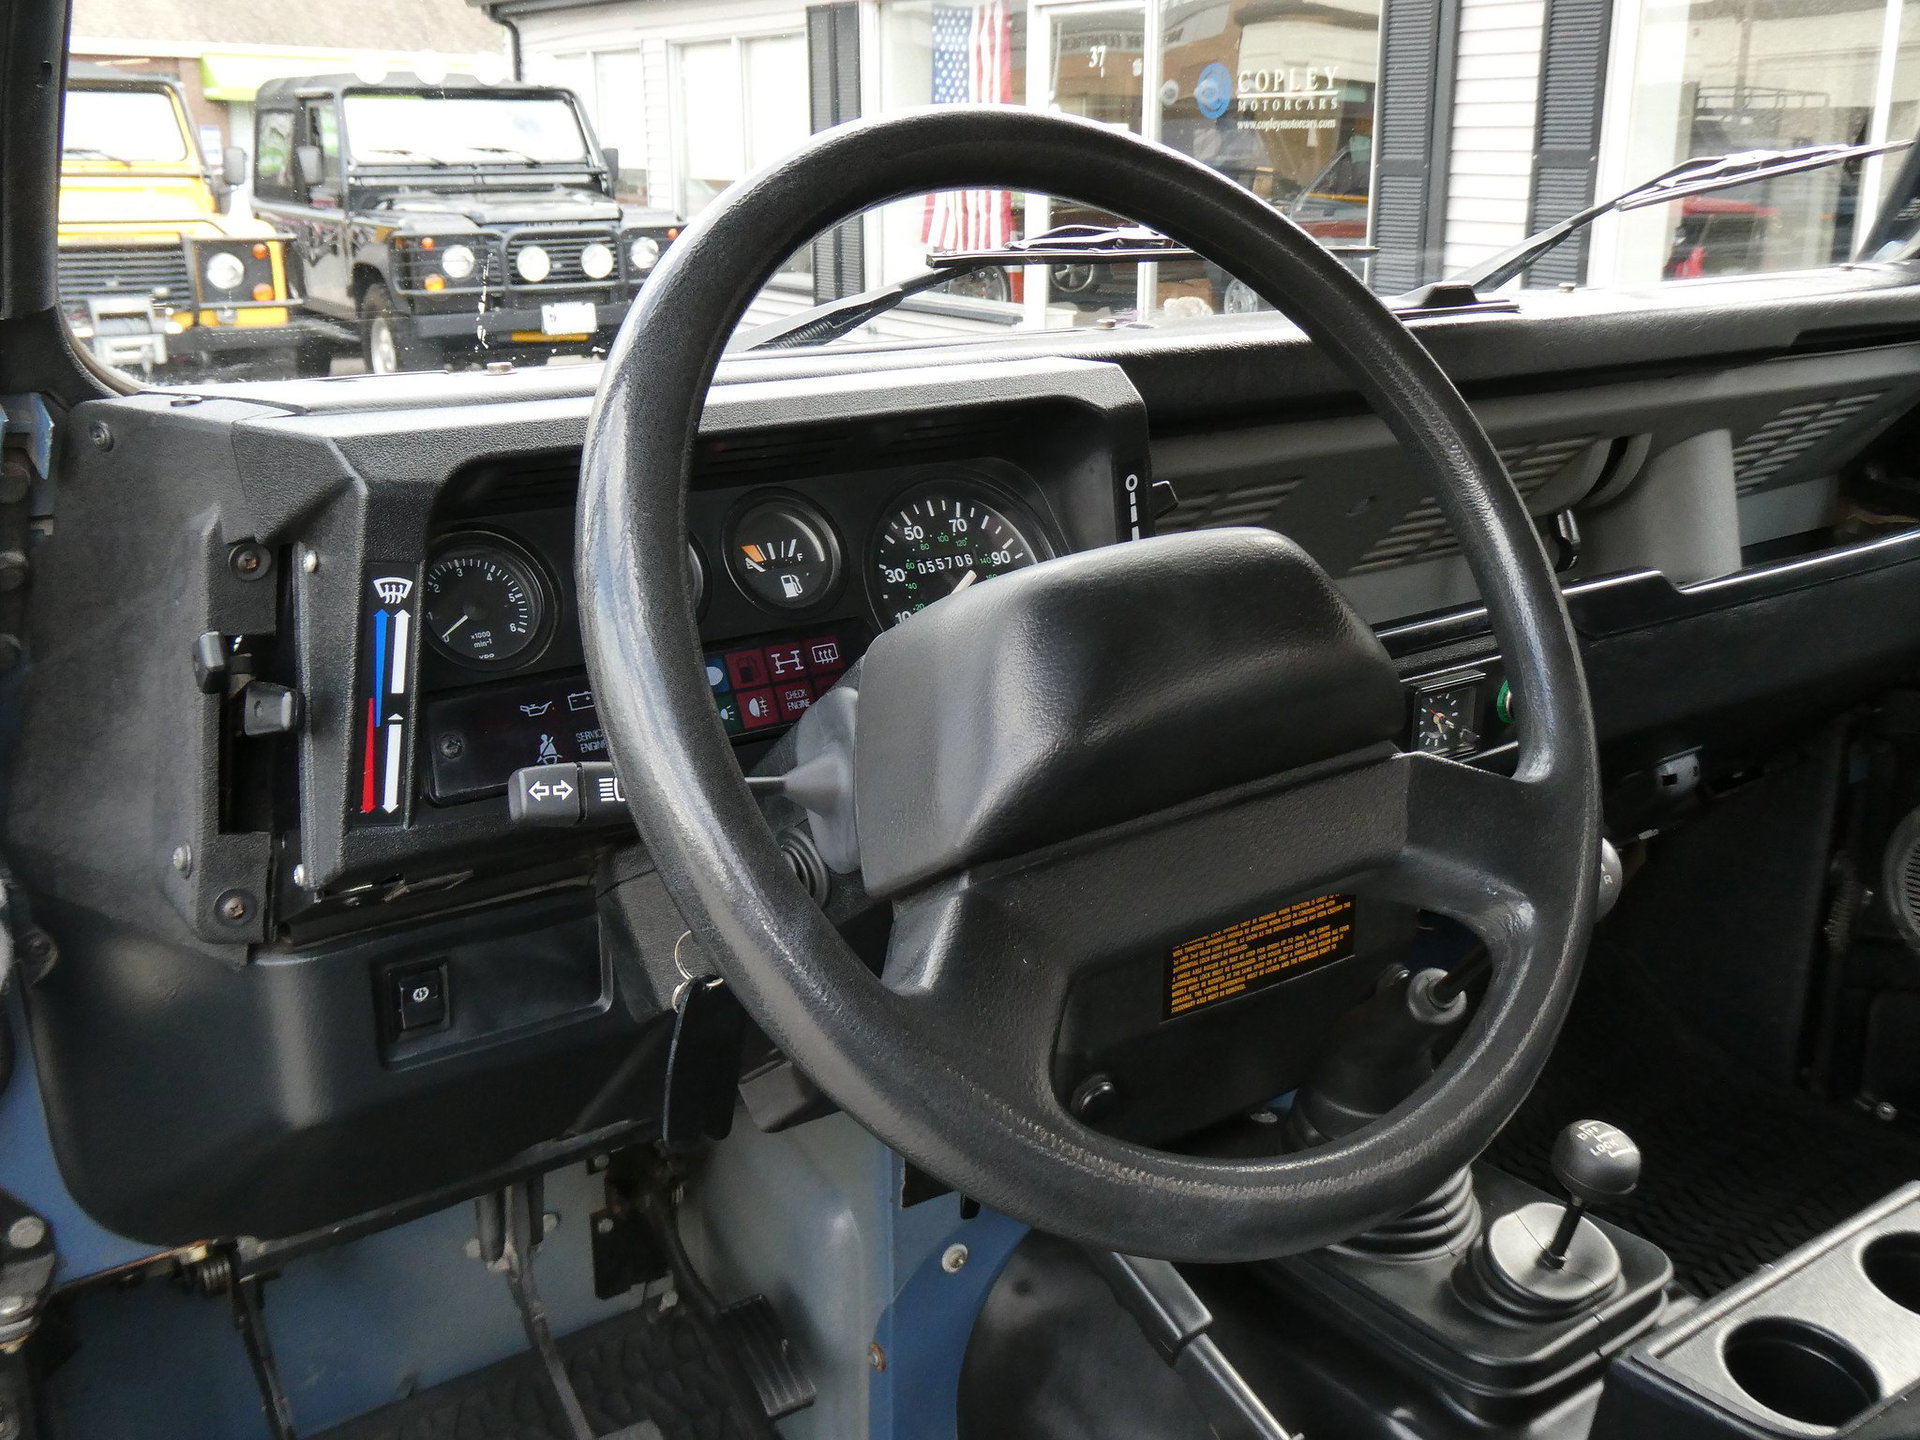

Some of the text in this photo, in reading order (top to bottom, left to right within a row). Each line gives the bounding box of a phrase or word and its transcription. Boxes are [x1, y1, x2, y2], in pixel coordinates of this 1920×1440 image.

[1089, 45, 1105, 68] 37
[1238, 66, 1338, 92] COPLEY
[1237, 97, 1338, 112] MOTORCARS
[1236, 117, 1336, 132] www.copleymotorcars.com
[948, 518, 968, 533] 70
[903, 525, 924, 541] 50
[936, 534, 950, 543] 100
[955, 539, 968, 547] 120
[797, 553, 803, 562] F
[917, 553, 974, 575] 055706
[991, 550, 1011, 565] 90
[456, 567, 463, 577] 3
[905, 562, 915, 570] 60
[486, 572, 493, 582] 4
[884, 567, 906, 584] 30
[433, 583, 441, 594] 2
[908, 582, 918, 590] 40
[508, 593, 516, 603] 5
[894, 610, 912, 624] 10
[509, 622, 517, 633] 6
[784, 689, 808, 701] CHECK
[786, 698, 811, 711] ENGINE
[575, 729, 604, 743] SERVIC
[580, 740, 609, 753] ENGIN
[1589, 1138, 1619, 1157] LOCK
